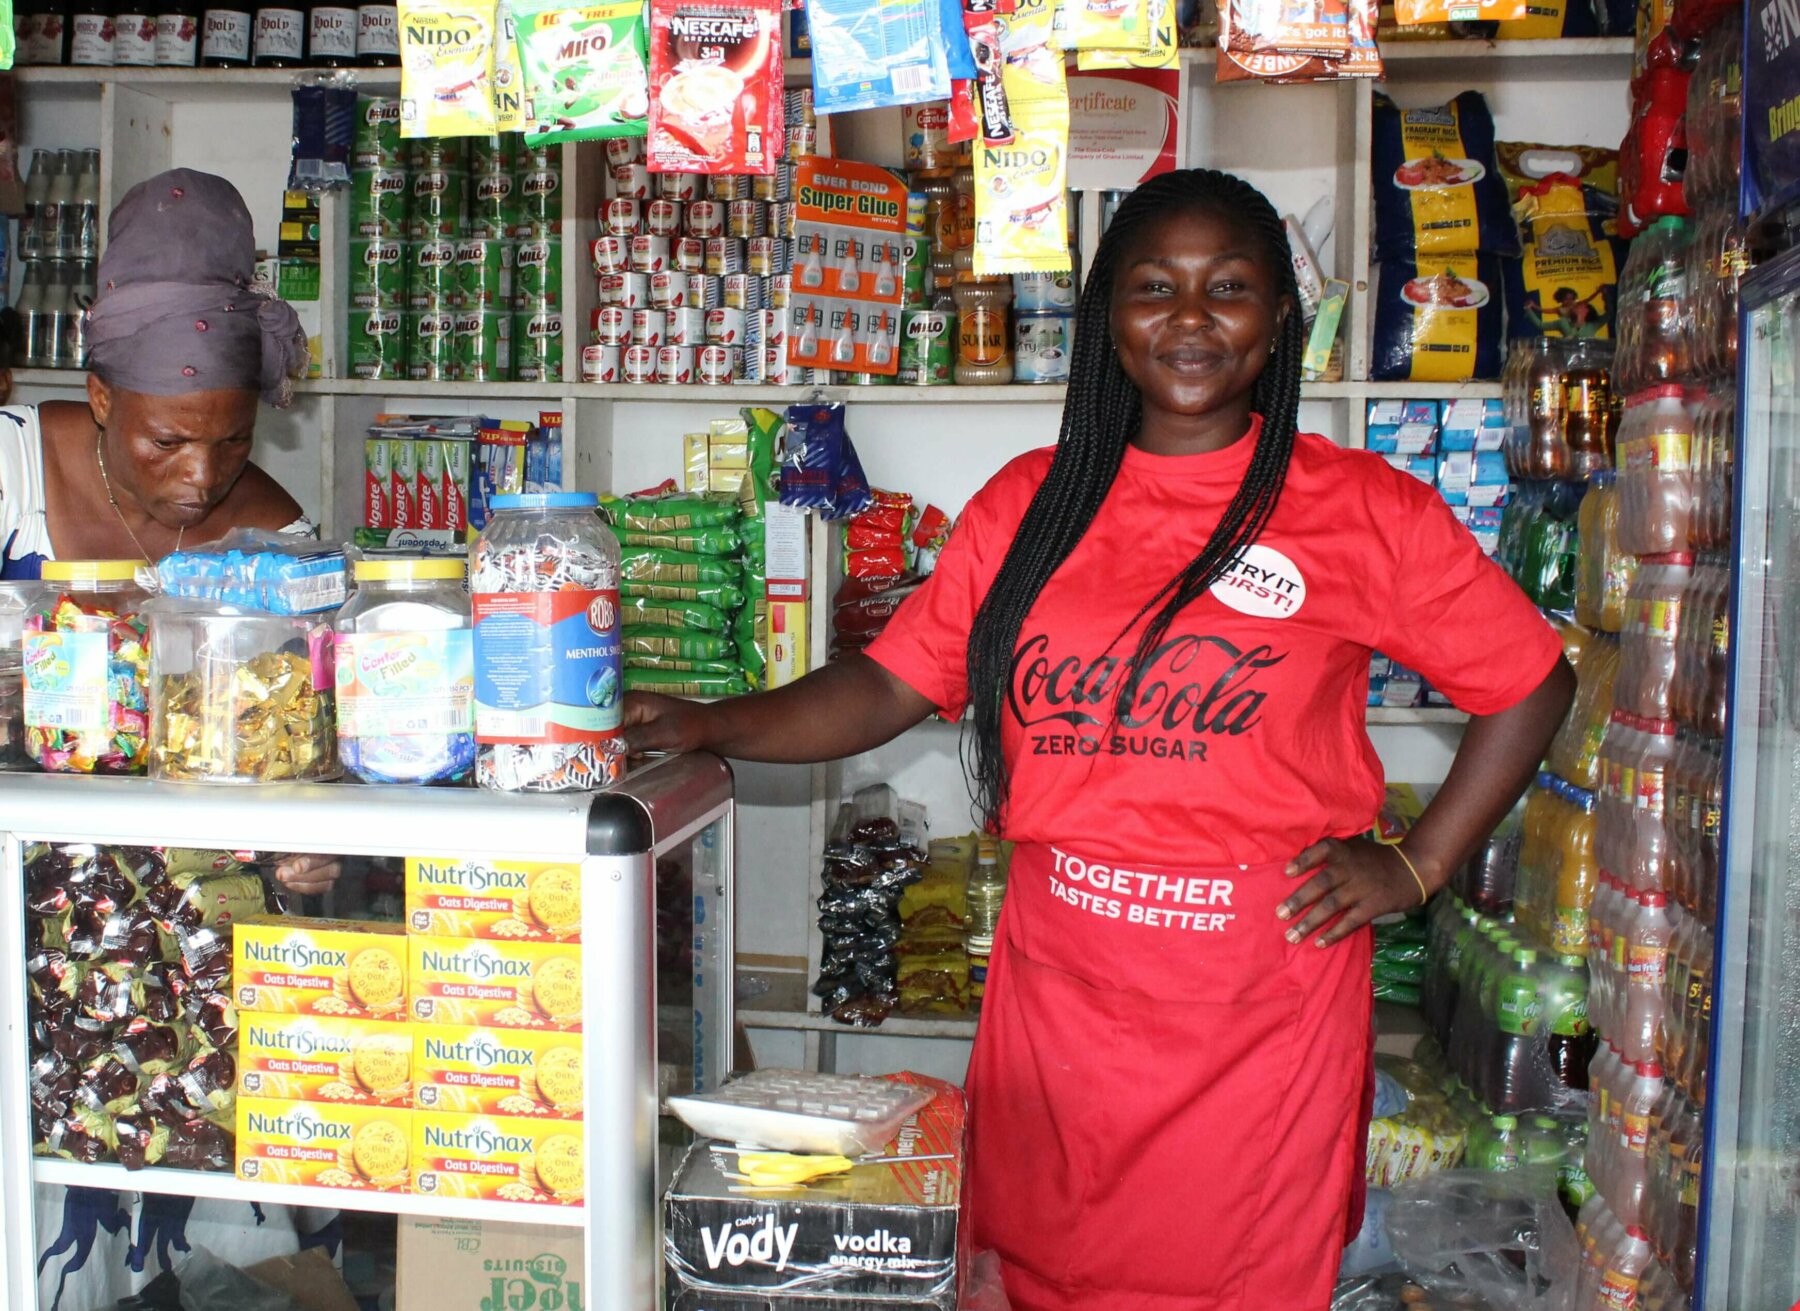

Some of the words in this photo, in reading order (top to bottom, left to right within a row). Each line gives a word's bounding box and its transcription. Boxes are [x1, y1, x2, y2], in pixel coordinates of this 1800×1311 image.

[407, 26, 471, 45] NIDO
[684, 36, 742, 44] BREAKFAST
[1305, 26, 1329, 39] got
[1069, 91, 1137, 112] ertificate
[983, 149, 1047, 169] NIDO
[813, 173, 847, 189] EVER
[851, 180, 889, 195] BOND
[800, 186, 854, 213] Super
[858, 195, 899, 218] Glue
[398, 539, 447, 550] Pepsodent
[1215, 573, 1294, 612] FIRST!
[591, 599, 615, 629] ROBB
[566, 646, 608, 660] MENTHOL
[379, 652, 417, 680] Filled
[1031, 735, 1099, 756] ZERO
[1108, 735, 1208, 762] SUGAR
[417, 861, 527, 890] NutriSnax
[1051, 847, 1234, 906] TOGETHER
[438, 896, 463, 909] Oats
[463, 897, 509, 912] Digestive
[1048, 876, 1122, 919] TASTES
[245, 939, 347, 968] NutriSnax
[421, 949, 531, 978] NutriSnax
[263, 973, 287, 986] Oats
[287, 974, 329, 989] Digestive
[442, 984, 467, 997] Oats
[467, 985, 512, 1000] Digestive
[249, 1026, 351, 1054] NutriSnax
[425, 1038, 534, 1067] NutriSnax
[268, 1060, 291, 1072] Oats
[291, 1061, 335, 1075] Digestive
[445, 1071, 469, 1084] Oats
[469, 1073, 515, 1087] Digestive
[248, 1112, 351, 1140] NutriSnax
[425, 1125, 533, 1153] NutriSnax
[897, 1125, 922, 1156] nergy
[267, 1146, 291, 1158] Oats
[291, 1147, 334, 1161] Digestive
[445, 1159, 468, 1172] Oats
[469, 1160, 515, 1175] Digestive
[735, 1215, 763, 1227] Cody's
[700, 1213, 799, 1272] Vody
[834, 1229, 911, 1253] vodka
[483, 1259, 564, 1272] BISCUITS
[829, 1254, 884, 1271] energy
